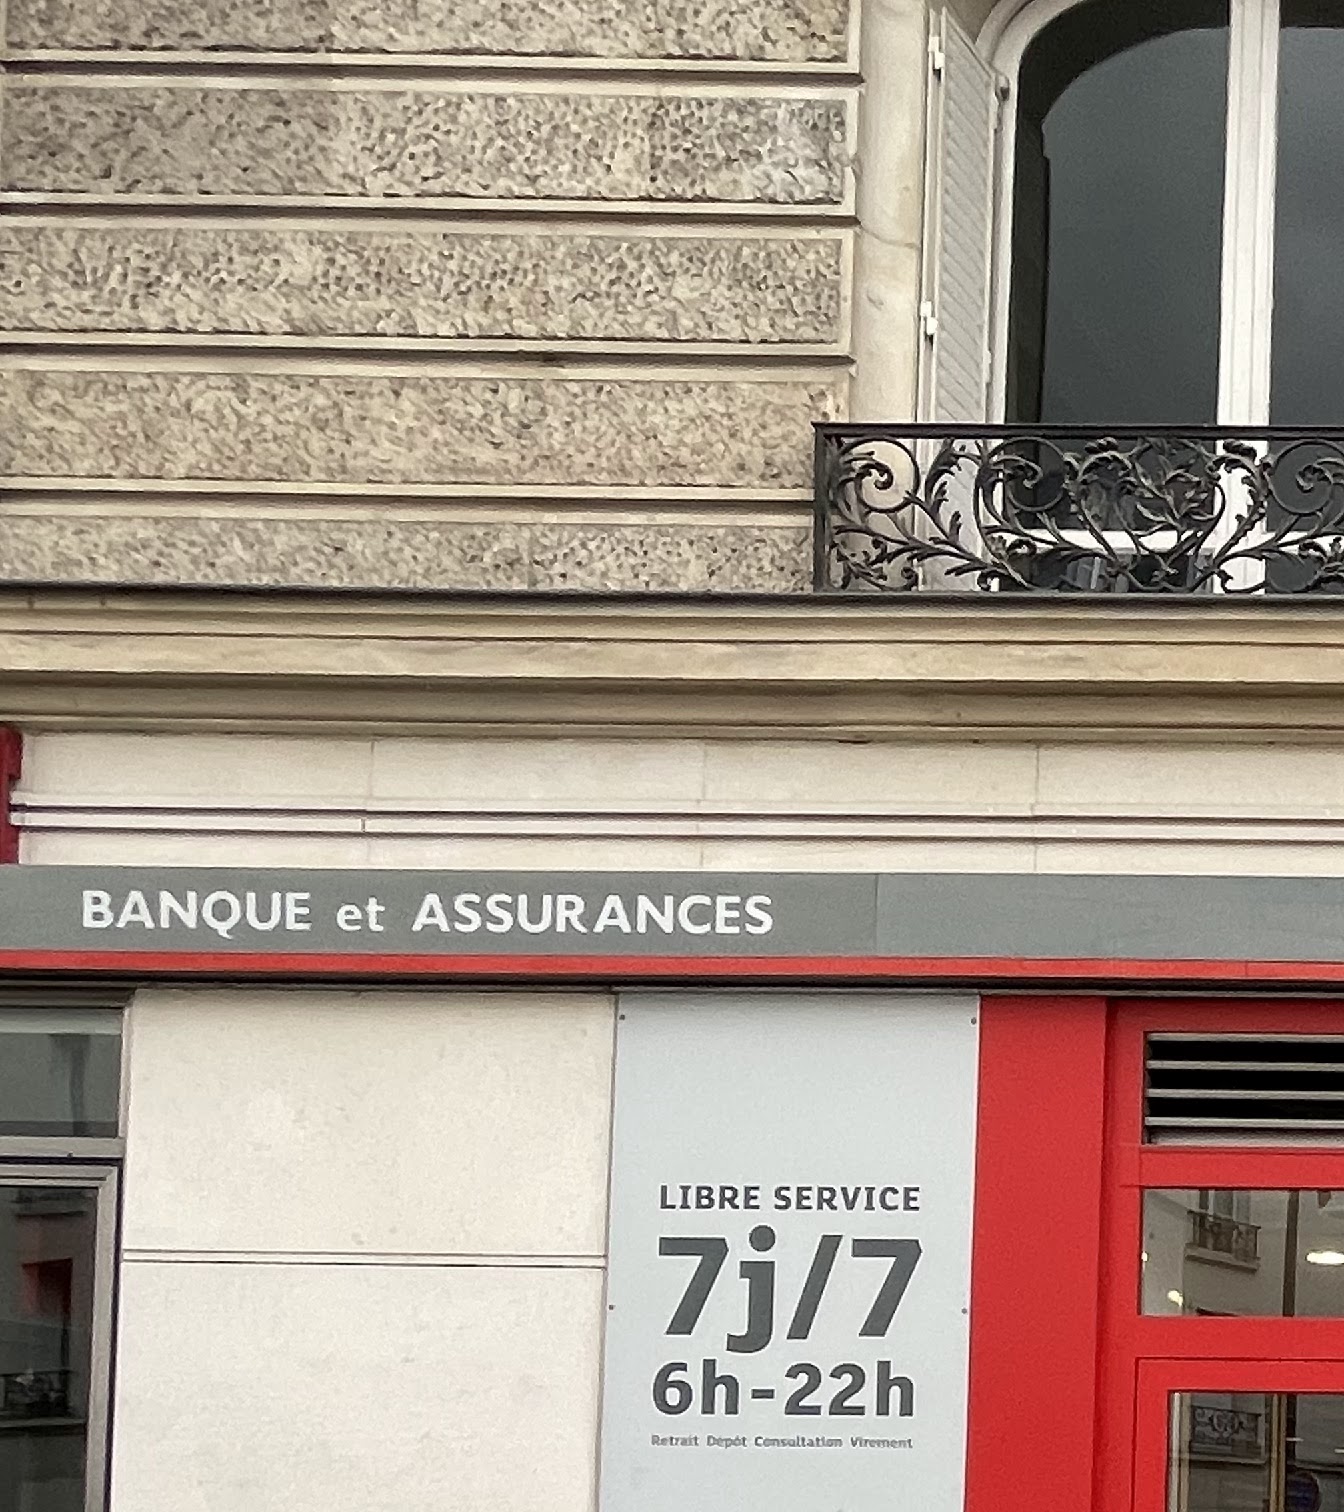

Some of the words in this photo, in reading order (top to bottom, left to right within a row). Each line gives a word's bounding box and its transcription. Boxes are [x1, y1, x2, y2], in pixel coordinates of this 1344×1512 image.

[82, 890, 311, 939] BANQUE
[336, 895, 385, 932] et
[411, 894, 774, 935] ASSURANCES
[659, 1185, 760, 1210] LIBRE
[774, 1186, 920, 1211] SERVICE
[658, 1225, 923, 1353] 7j/7
[652, 1359, 914, 1417] 6h-22h
[651, 1435, 699, 1447] Retrait
[754, 1435, 843, 1448] Consultation
[851, 1436, 913, 1449] Virement
